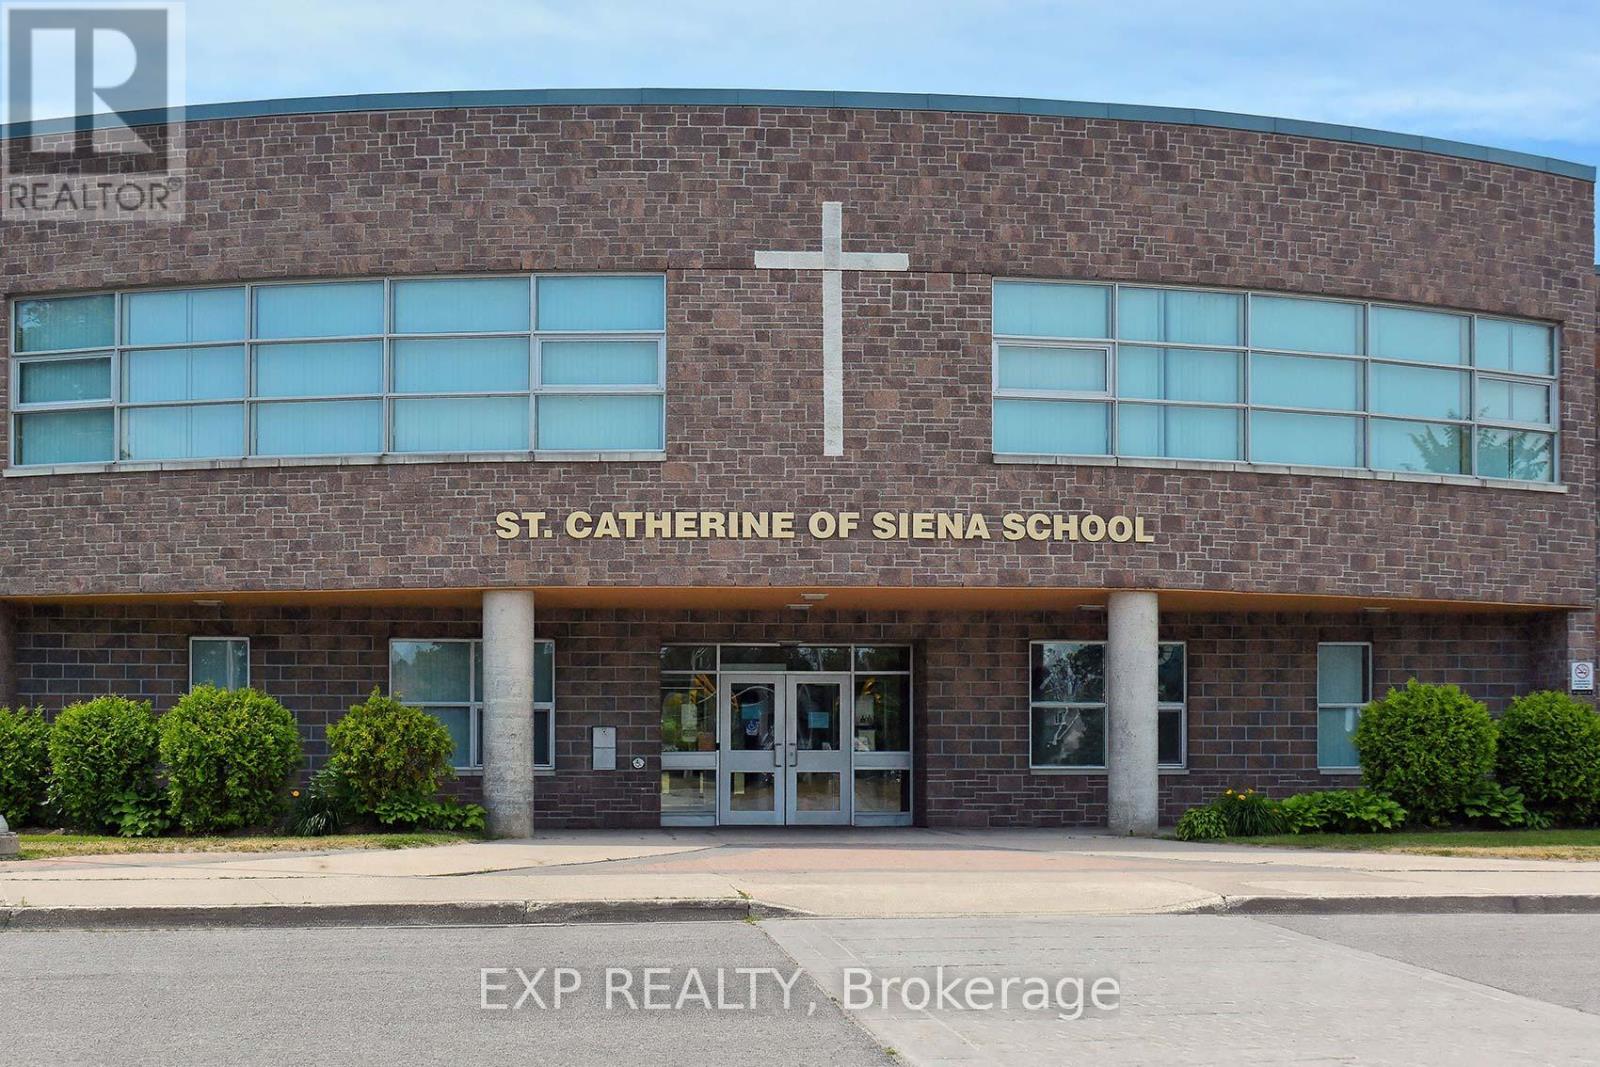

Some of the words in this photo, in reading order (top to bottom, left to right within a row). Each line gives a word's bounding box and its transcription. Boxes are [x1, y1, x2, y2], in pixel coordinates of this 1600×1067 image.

[495, 511, 552, 539] ST.
[565, 511, 795, 539] CATHERINE
[808, 511, 860, 539] OF
[872, 512, 991, 540] SIENA
[1002, 512, 1154, 543] SCHOOL
